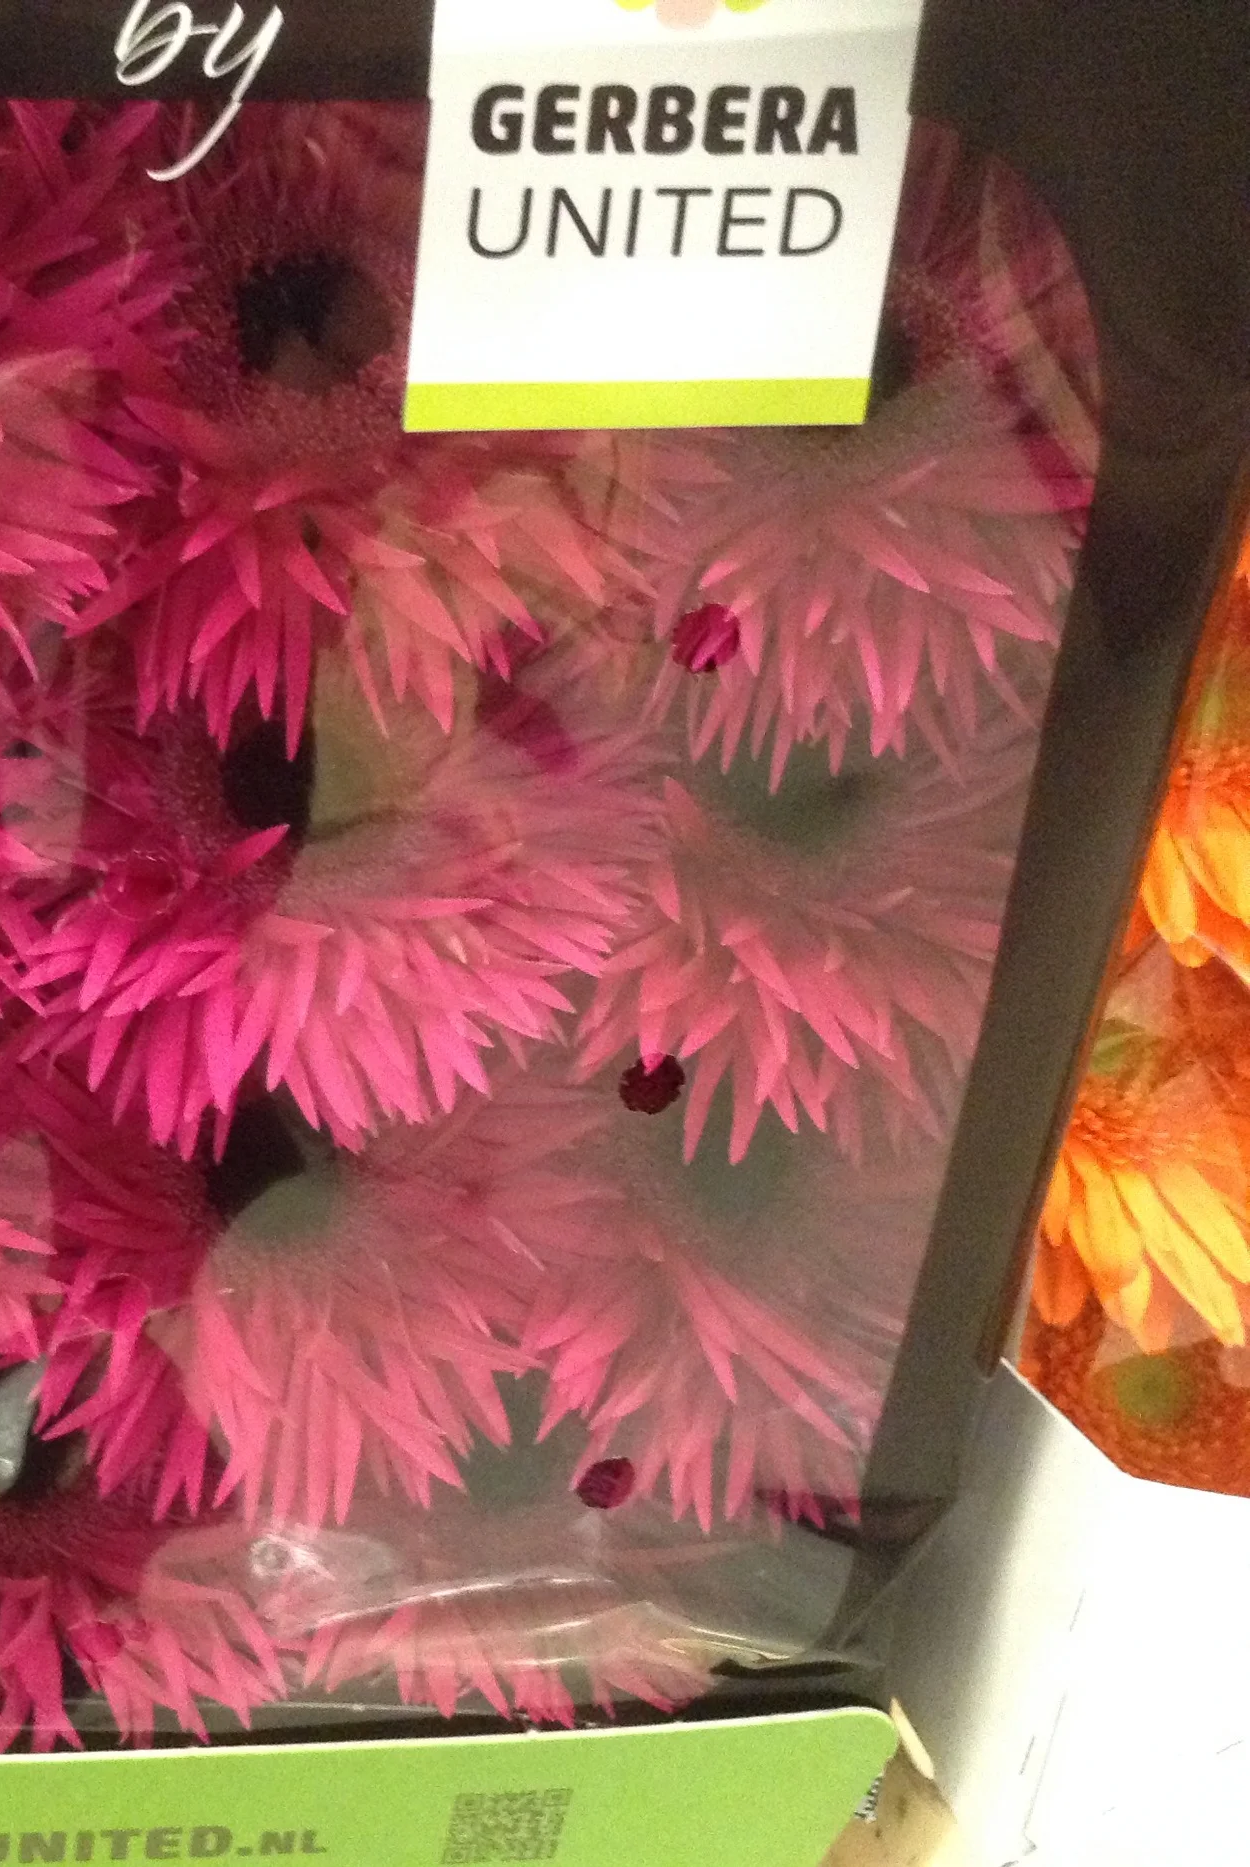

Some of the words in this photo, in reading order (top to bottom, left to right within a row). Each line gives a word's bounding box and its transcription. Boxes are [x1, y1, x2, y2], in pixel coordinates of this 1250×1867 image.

[114, 0, 286, 182] by
[470, 83, 860, 156] GERBERA
[466, 187, 844, 259] UNITED
